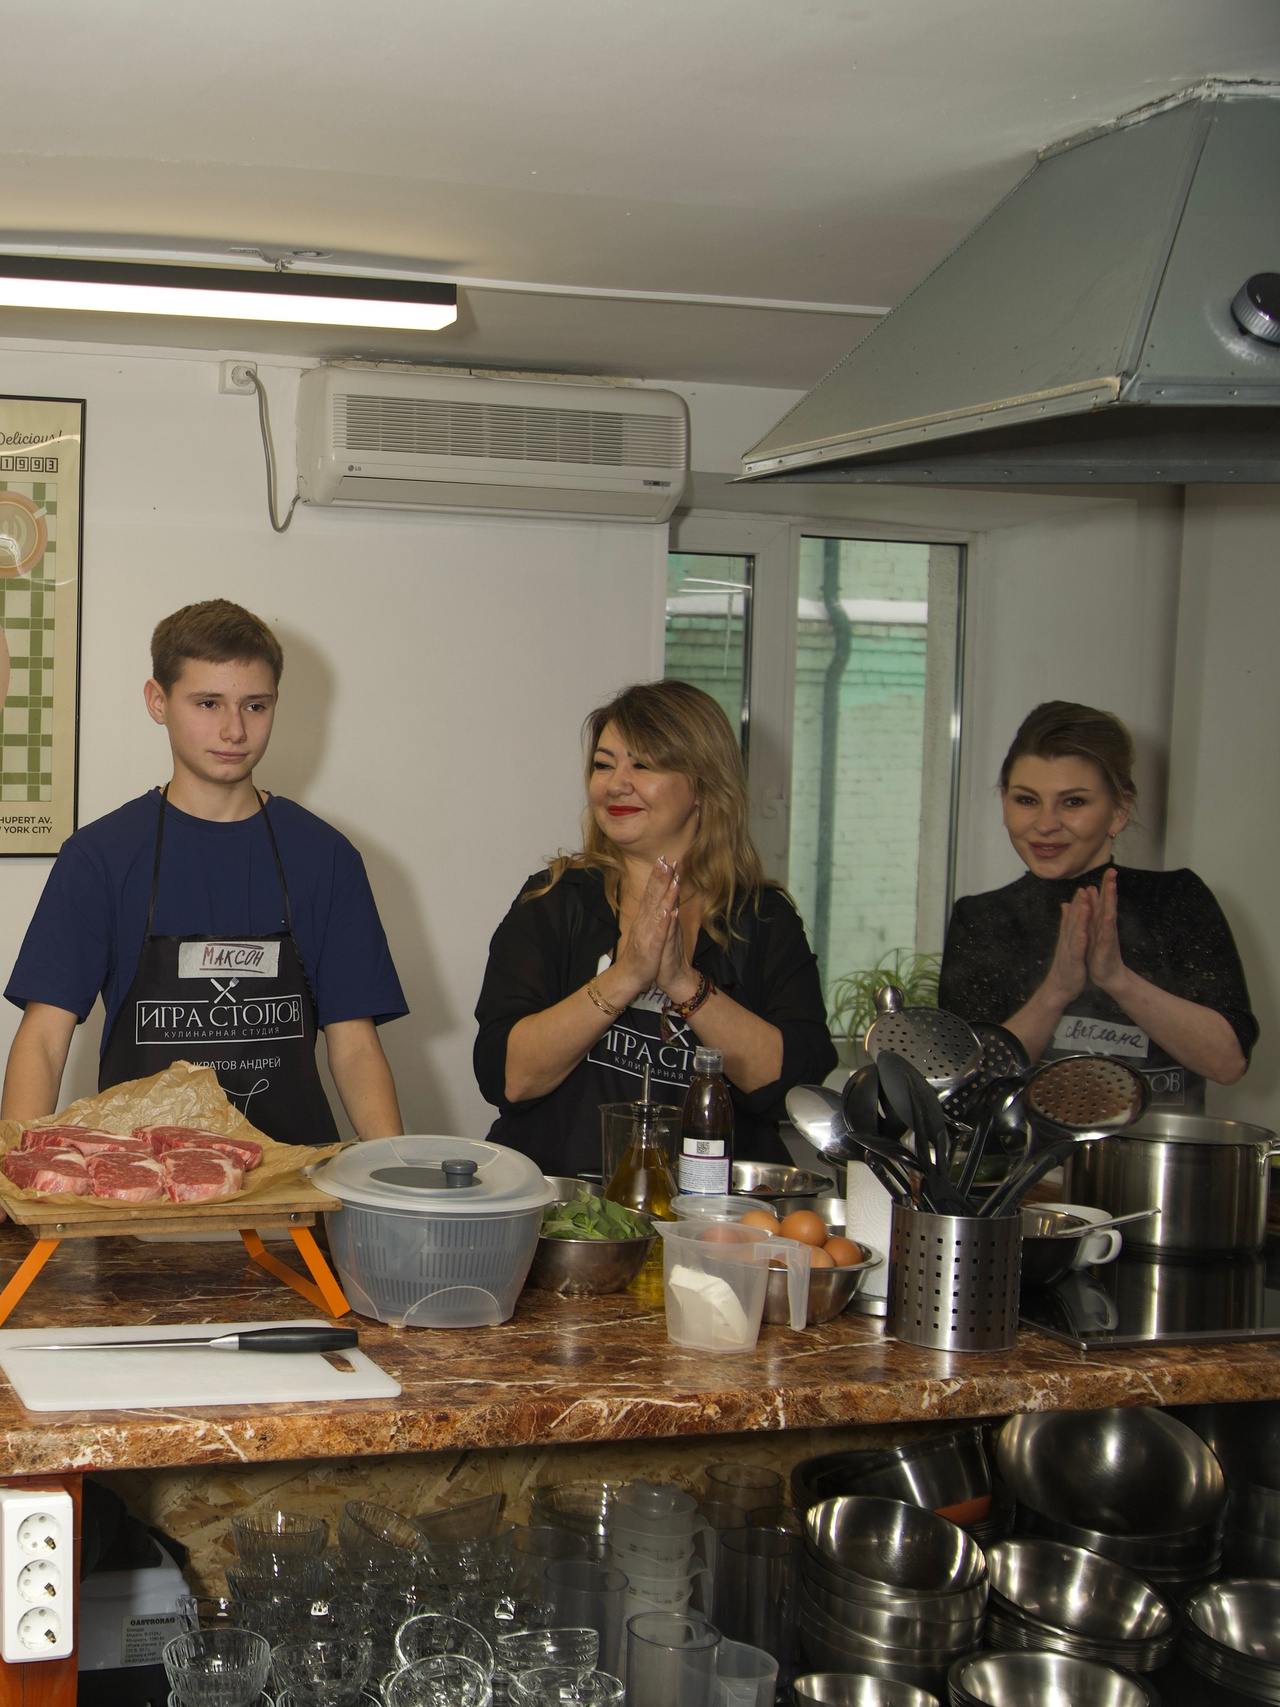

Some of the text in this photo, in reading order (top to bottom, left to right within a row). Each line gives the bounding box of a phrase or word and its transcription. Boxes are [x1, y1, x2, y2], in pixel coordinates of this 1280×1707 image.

[2, 457, 57, 471] 1993
[37, 816, 53, 824] AV.
[3, 826, 30, 834] YORK
[31, 826, 53, 834] CITY
[141, 1001, 300, 1028] ИГРА СТОЛОВ
[164, 1026, 280, 1038] КУЛИНАРНАЯ СТУДИЯ
[239, 1056, 281, 1071] АНДРЕЙ
